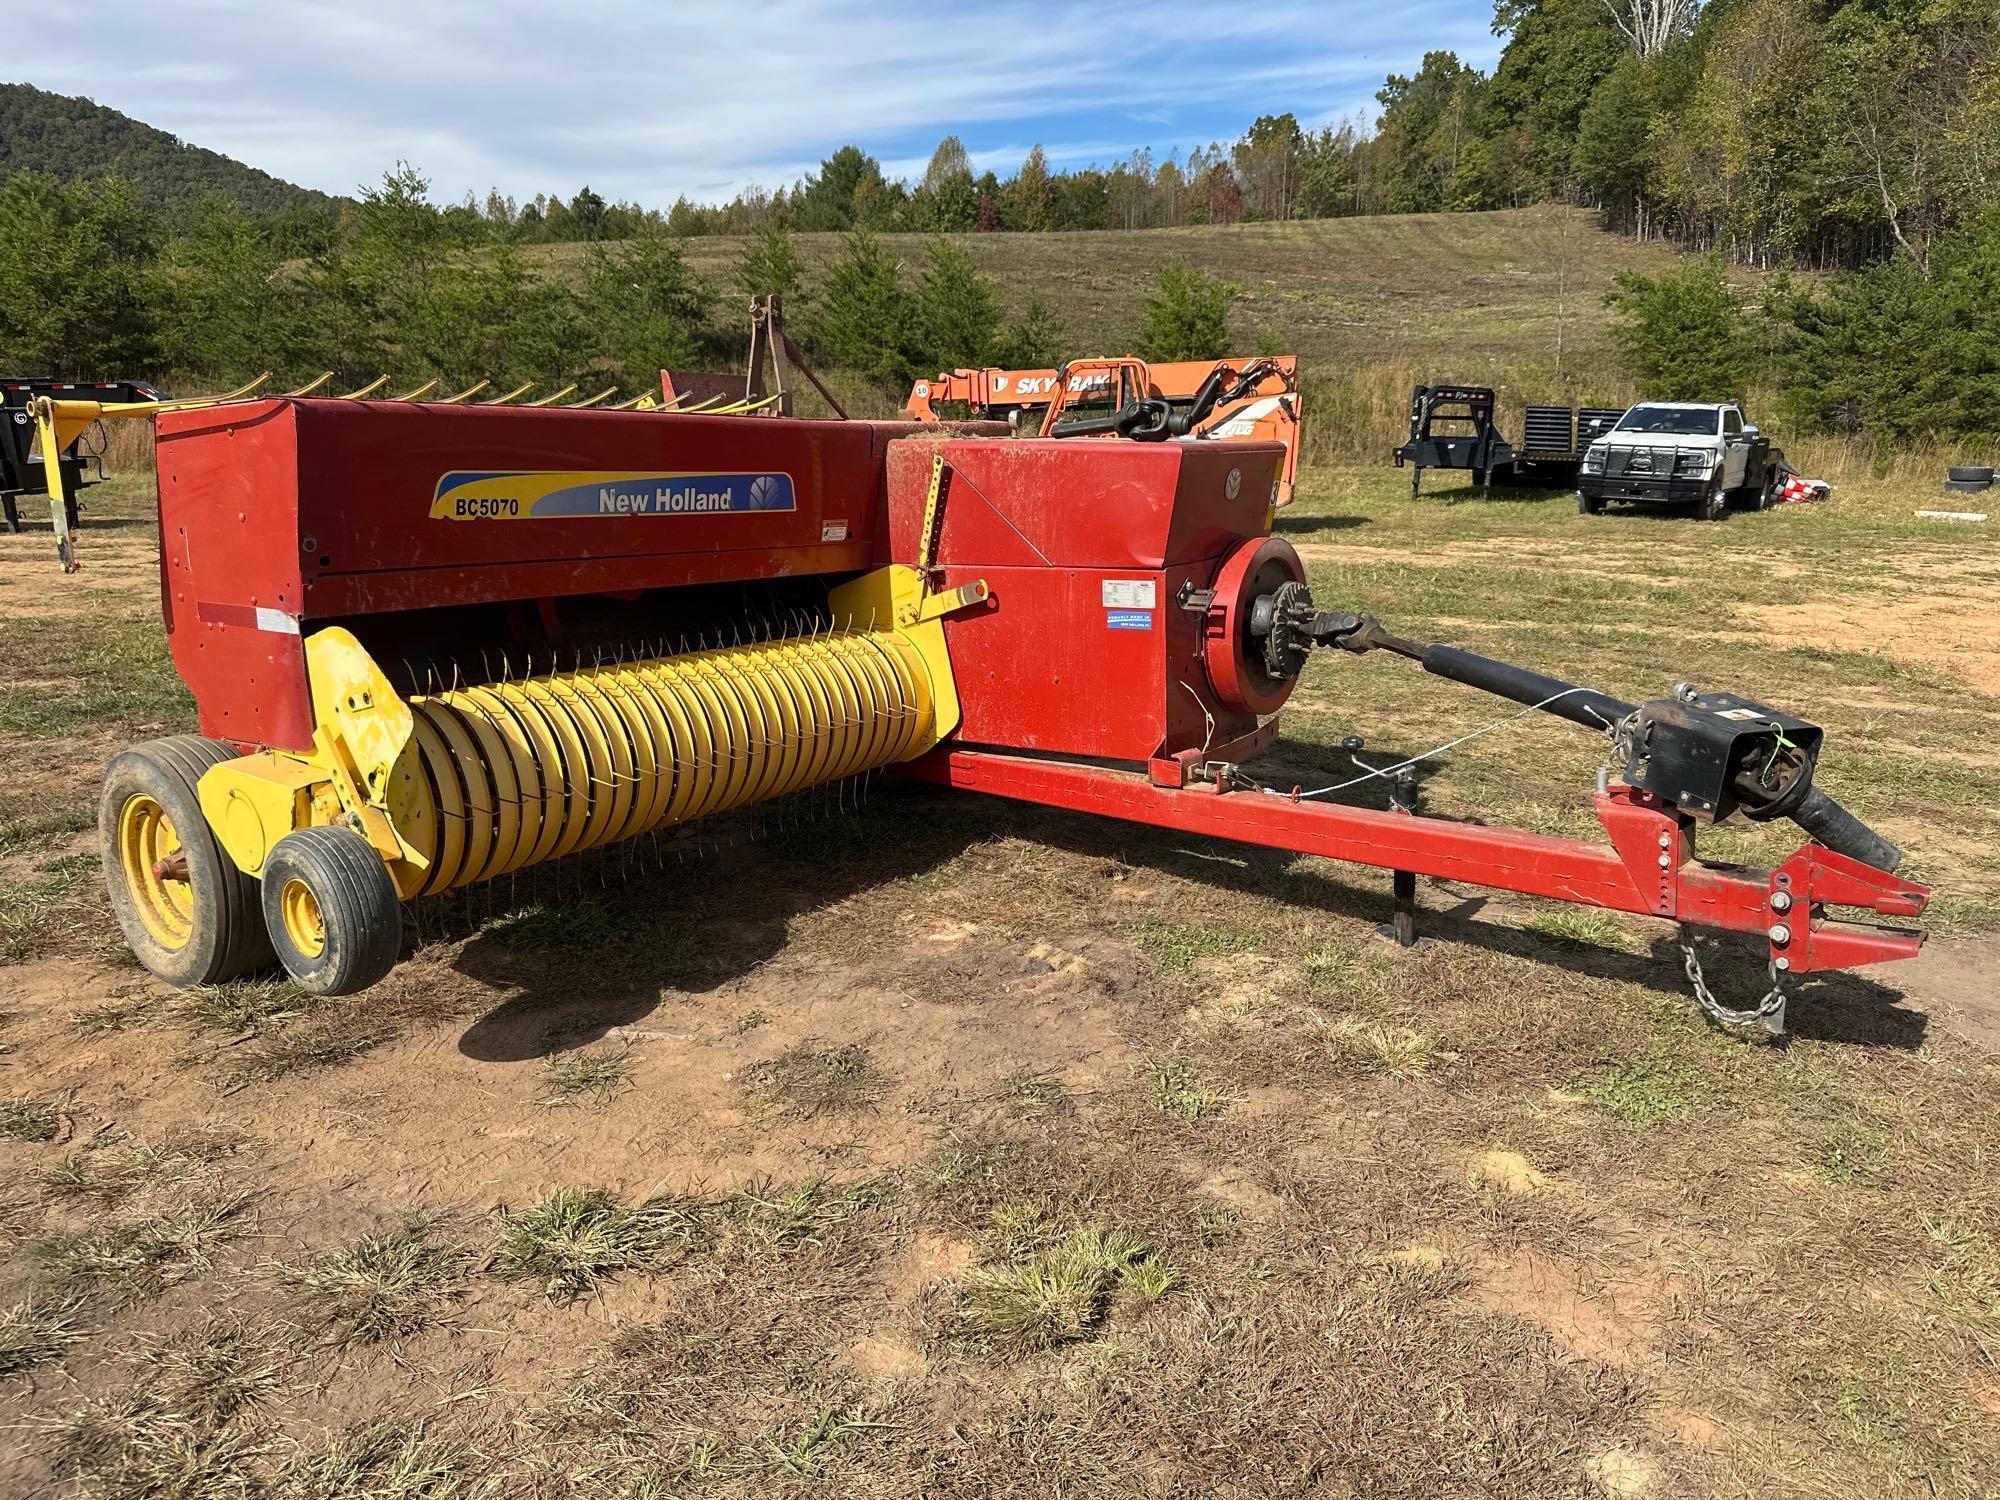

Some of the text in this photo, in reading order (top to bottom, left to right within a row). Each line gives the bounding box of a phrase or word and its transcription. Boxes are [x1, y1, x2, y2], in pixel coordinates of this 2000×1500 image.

[1016, 374, 1110, 394] SKYRAK
[455, 498, 519, 516] BC5070
[599, 487, 732, 513] New Holland
